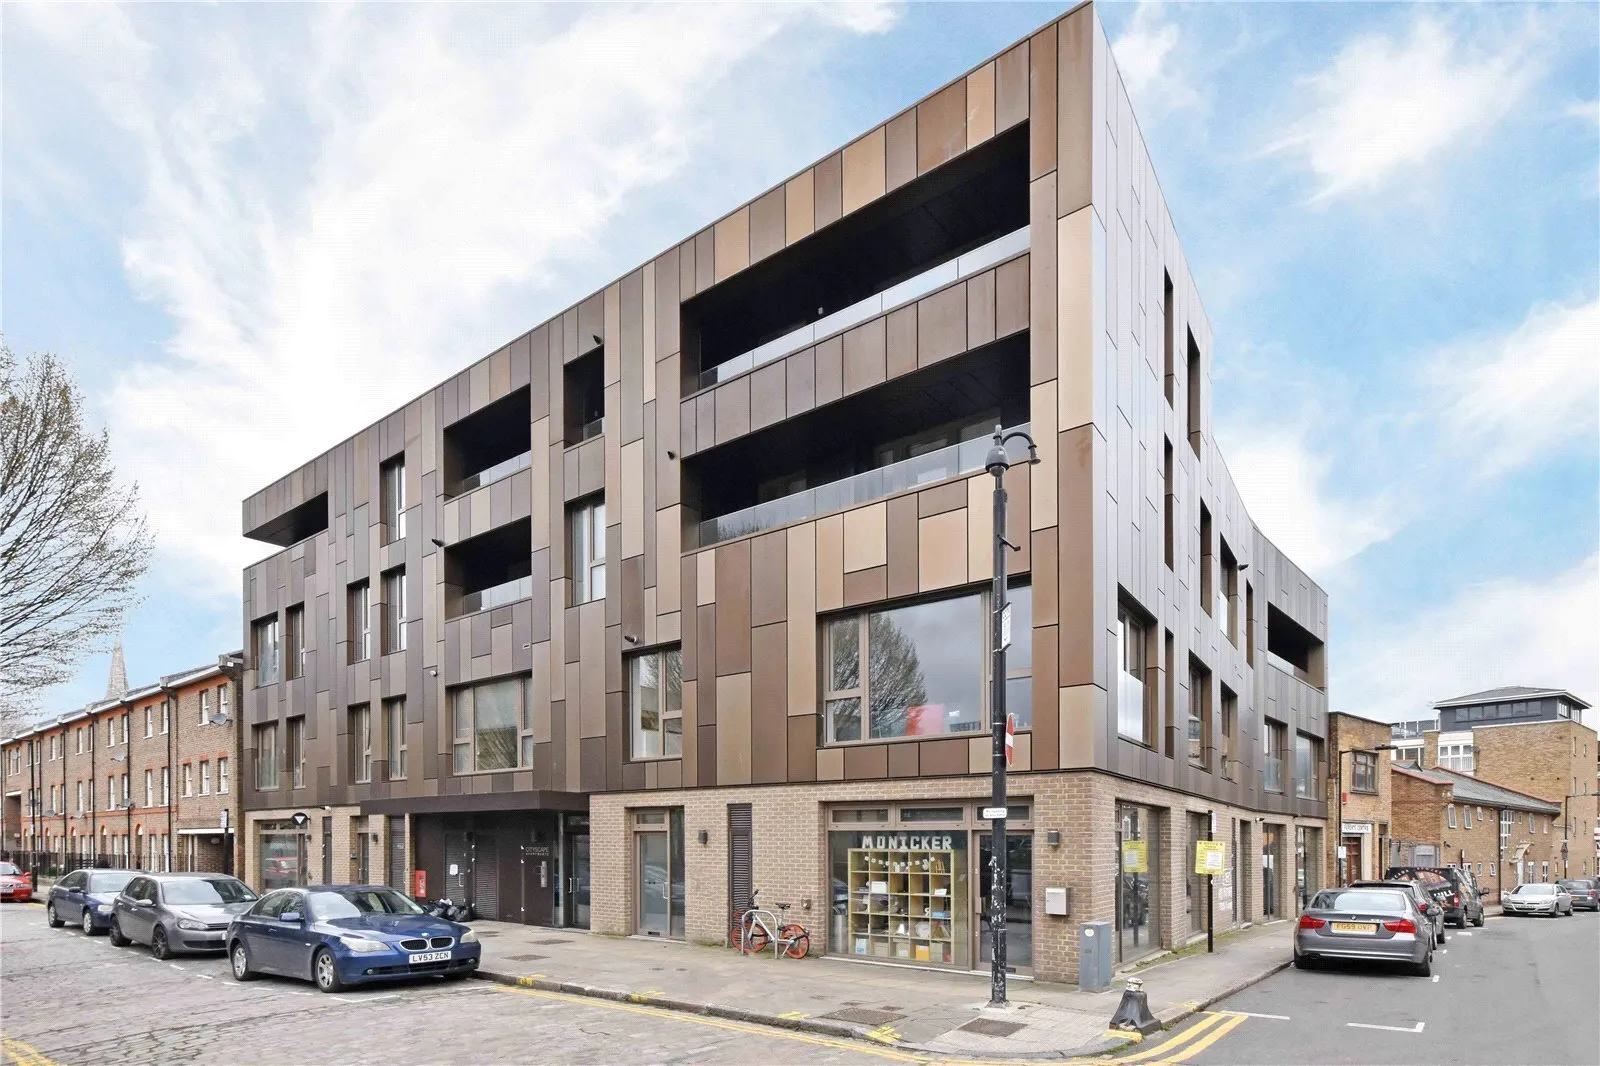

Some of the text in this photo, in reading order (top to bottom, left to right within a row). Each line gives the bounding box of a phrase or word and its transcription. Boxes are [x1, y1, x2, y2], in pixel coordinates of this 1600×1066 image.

[862, 835, 952, 850] MONICKER
[412, 951, 449, 962] LV53 ZCN
